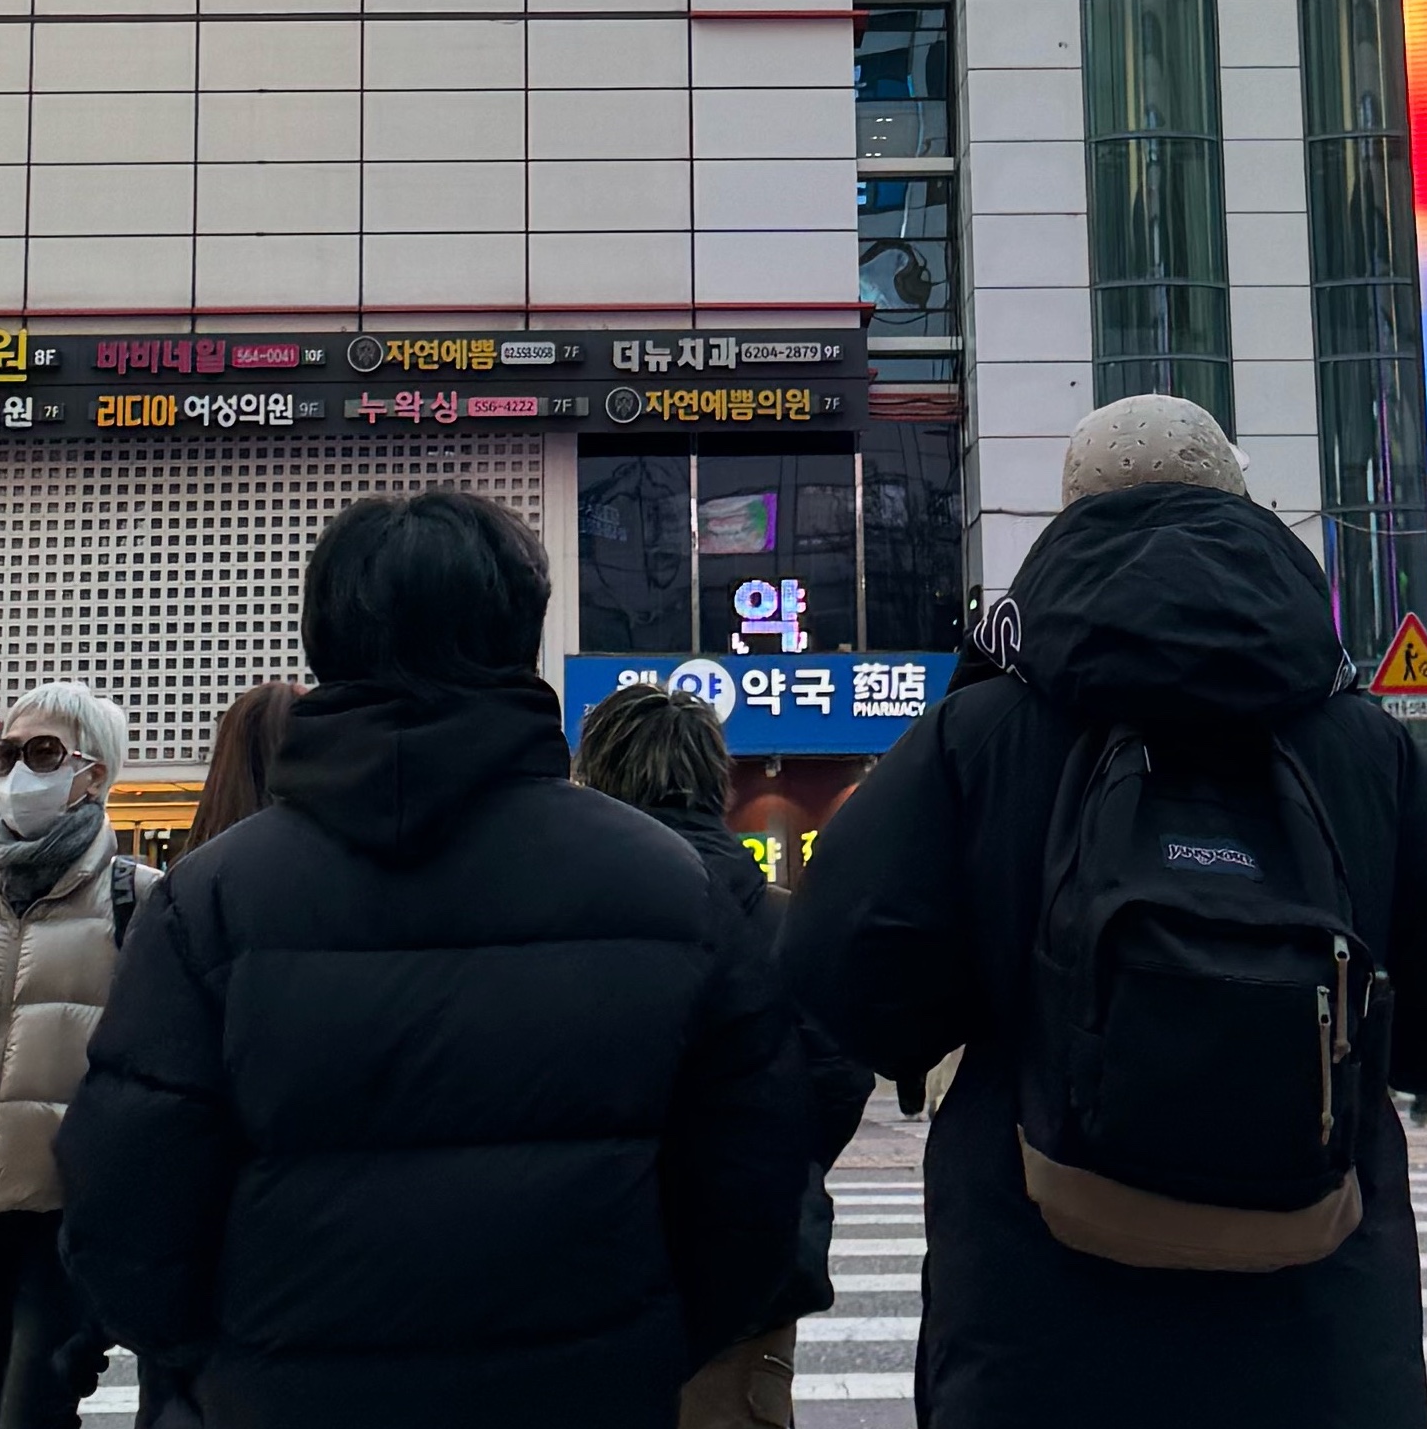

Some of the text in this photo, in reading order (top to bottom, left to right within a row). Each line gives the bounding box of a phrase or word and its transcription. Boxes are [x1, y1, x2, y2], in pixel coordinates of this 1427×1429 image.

[34, 348, 57, 367] 8F
[97, 340, 226, 375] 바비네일
[386, 338, 497, 371] 자연예쁨
[563, 345, 581, 359] 7F
[613, 337, 841, 373] 더뉴치과 6204-2879 9F
[97, 393, 319, 428] 리디아 여성의원 9F
[553, 399, 572, 414] 7F
[645, 388, 841, 422] 자연예쁨의원 7F
[741, 668, 836, 716] 약국
[853, 662, 927, 702] 药店
[852, 700, 928, 717] PHARMACY
